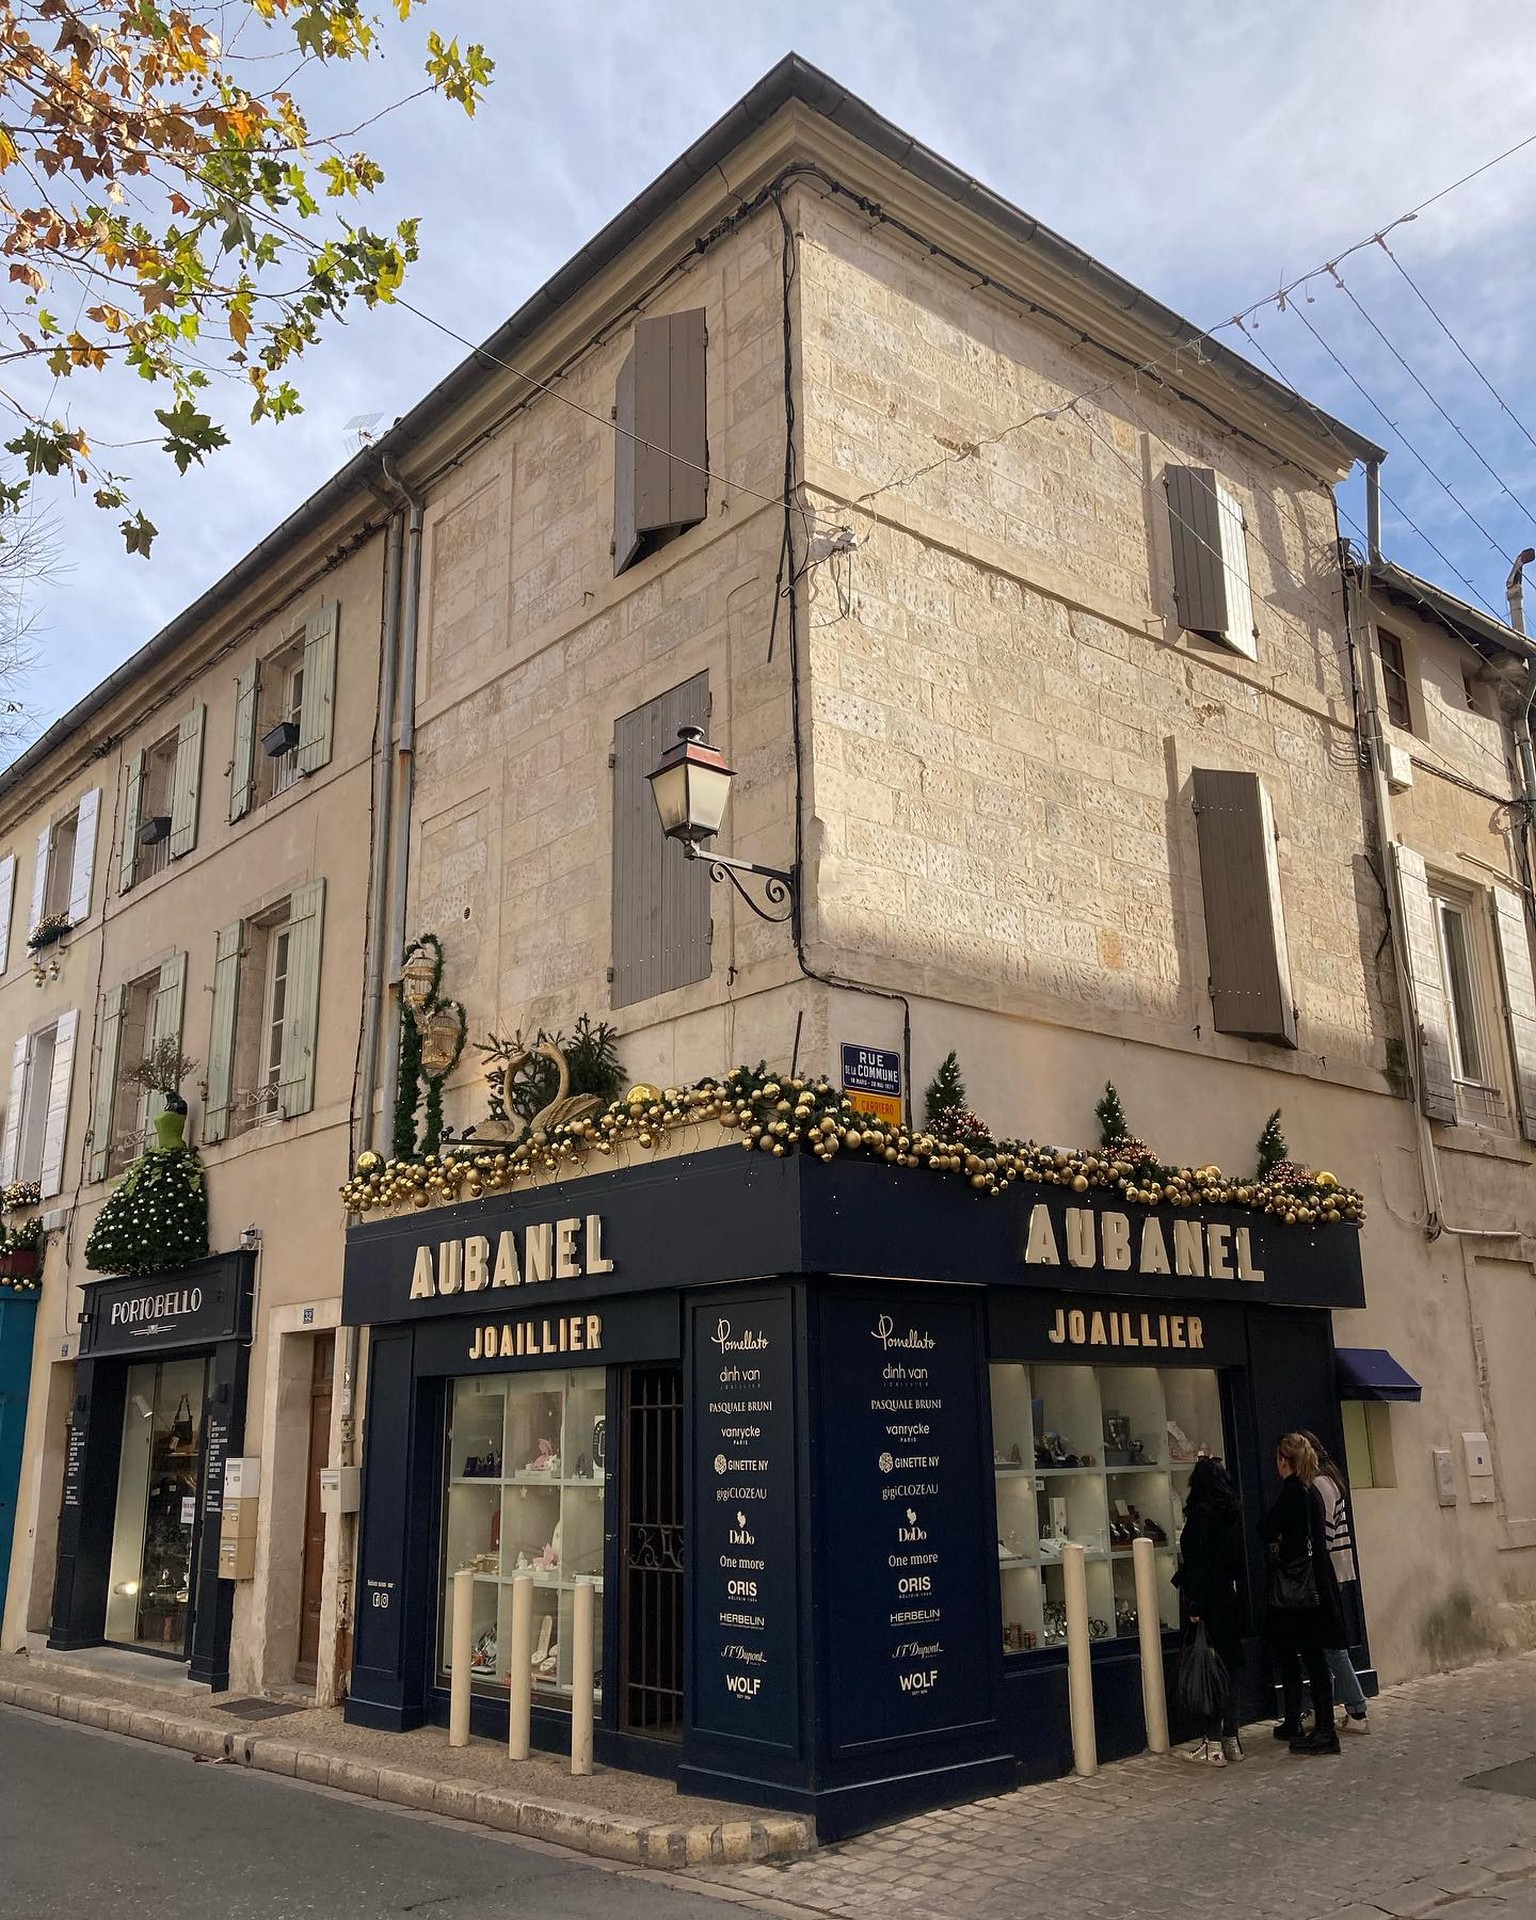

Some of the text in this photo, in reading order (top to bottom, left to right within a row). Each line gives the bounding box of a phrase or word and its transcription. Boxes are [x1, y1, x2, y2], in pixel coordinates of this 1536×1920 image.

[859, 1051, 884, 1066] RUE
[844, 1064, 851, 1075] DE
[857, 1064, 898, 1083] COMMUNE
[1024, 1203, 1266, 1282] AUBANEL
[409, 1214, 614, 1300] AUBANEL
[110, 1287, 202, 1326] PORTOBELLO
[468, 1314, 602, 1360] JOAILLIER
[710, 1318, 769, 1354] Pomellato
[870, 1313, 936, 1351] Pomellato
[1048, 1308, 1204, 1349] JOAILLIER
[720, 1365, 761, 1382] dinh van
[882, 1362, 928, 1379] dinh van
[709, 1400, 772, 1414] PASQUALE BRUNI
[871, 1399, 942, 1412] PASQUALE BRUNI
[721, 1425, 761, 1440] vanrycke
[885, 1422, 930, 1437] vanrycke
[728, 1460, 769, 1471] GINETTE NY
[894, 1456, 940, 1469] GINETTE NY
[720, 1555, 765, 1570] One more
[888, 1553, 939, 1567] One more
[727, 1580, 758, 1597] ORIS
[898, 1576, 931, 1593] ORIS
[720, 1612, 765, 1626] HERBELIN
[890, 1608, 941, 1623] HERBELIN
[735, 1645, 767, 1664] Dupont
[909, 1641, 944, 1659] Dupont
[726, 1674, 761, 1695] WOLF
[899, 1670, 938, 1691] WOLF
